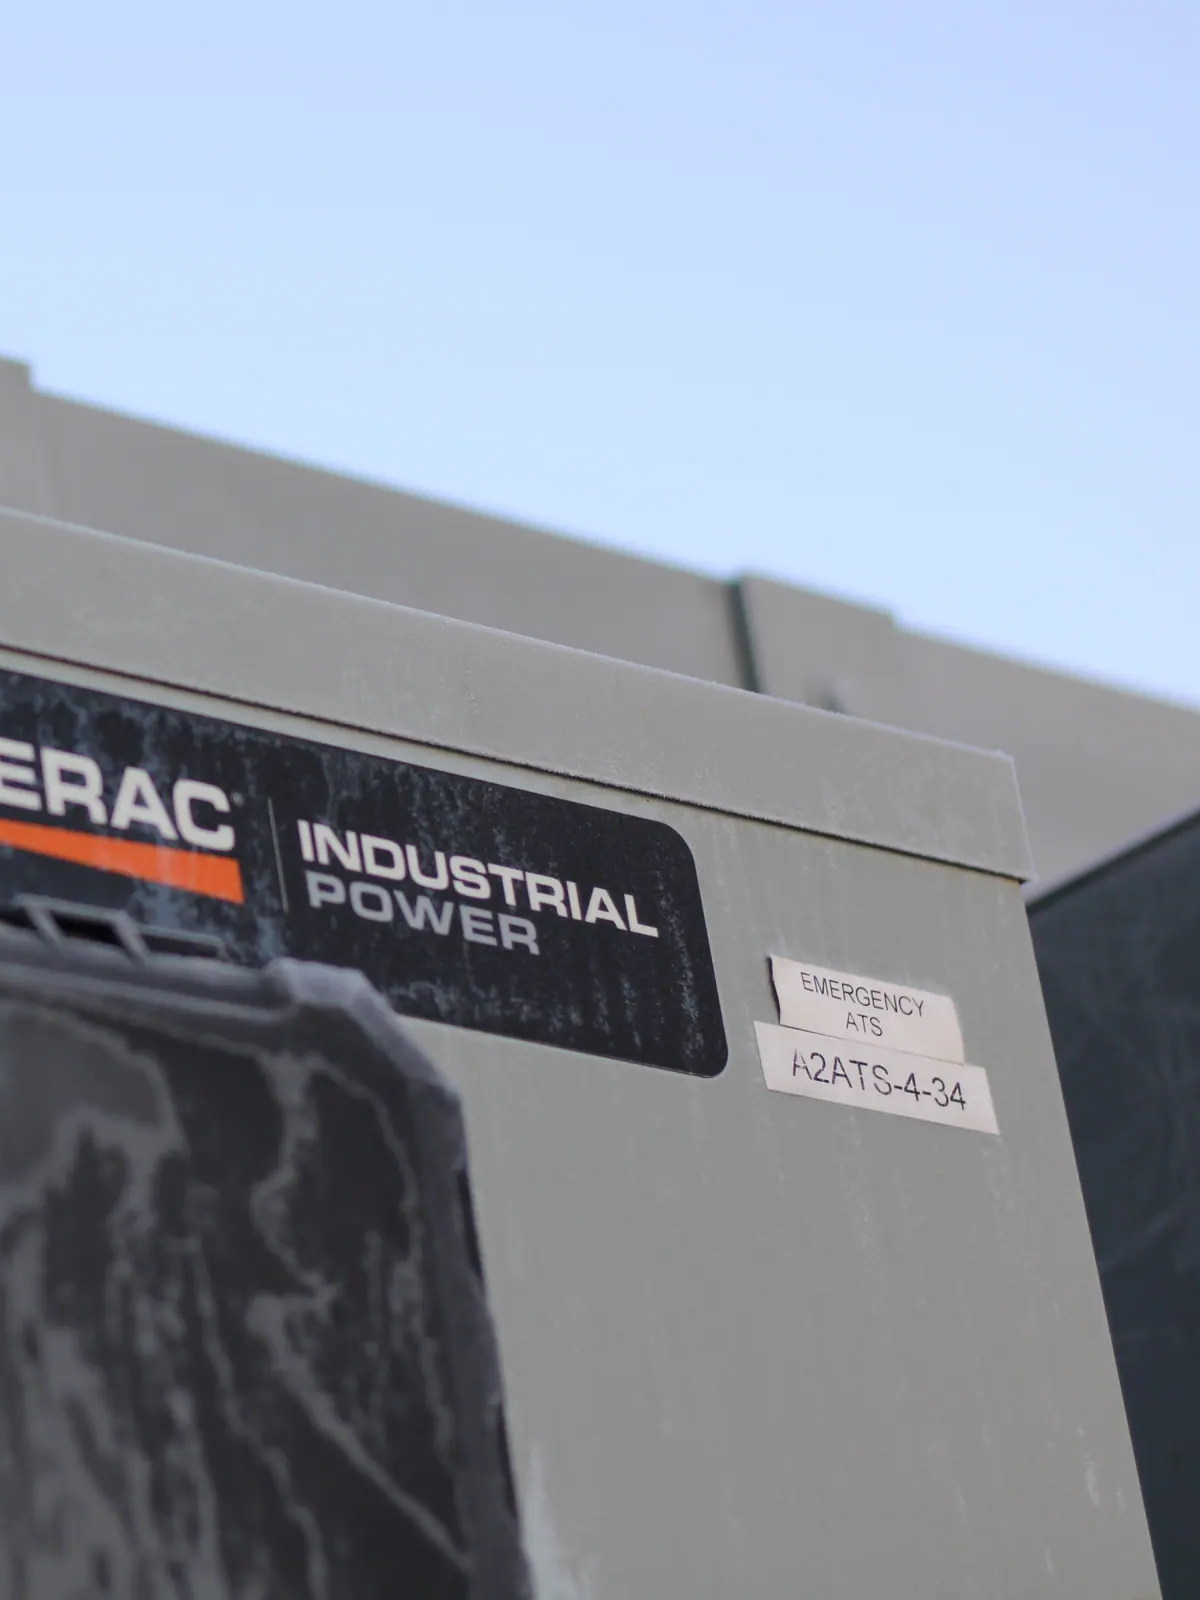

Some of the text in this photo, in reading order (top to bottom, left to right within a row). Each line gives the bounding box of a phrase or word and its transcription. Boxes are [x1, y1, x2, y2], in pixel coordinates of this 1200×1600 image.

[297, 819, 659, 938] INDUSTRIAL
[305, 871, 541, 956] POWER
[800, 971, 925, 1018] EMERGENCY
[845, 1011, 884, 1037] ATS
[792, 1049, 967, 1111] A2ATS-4-34
